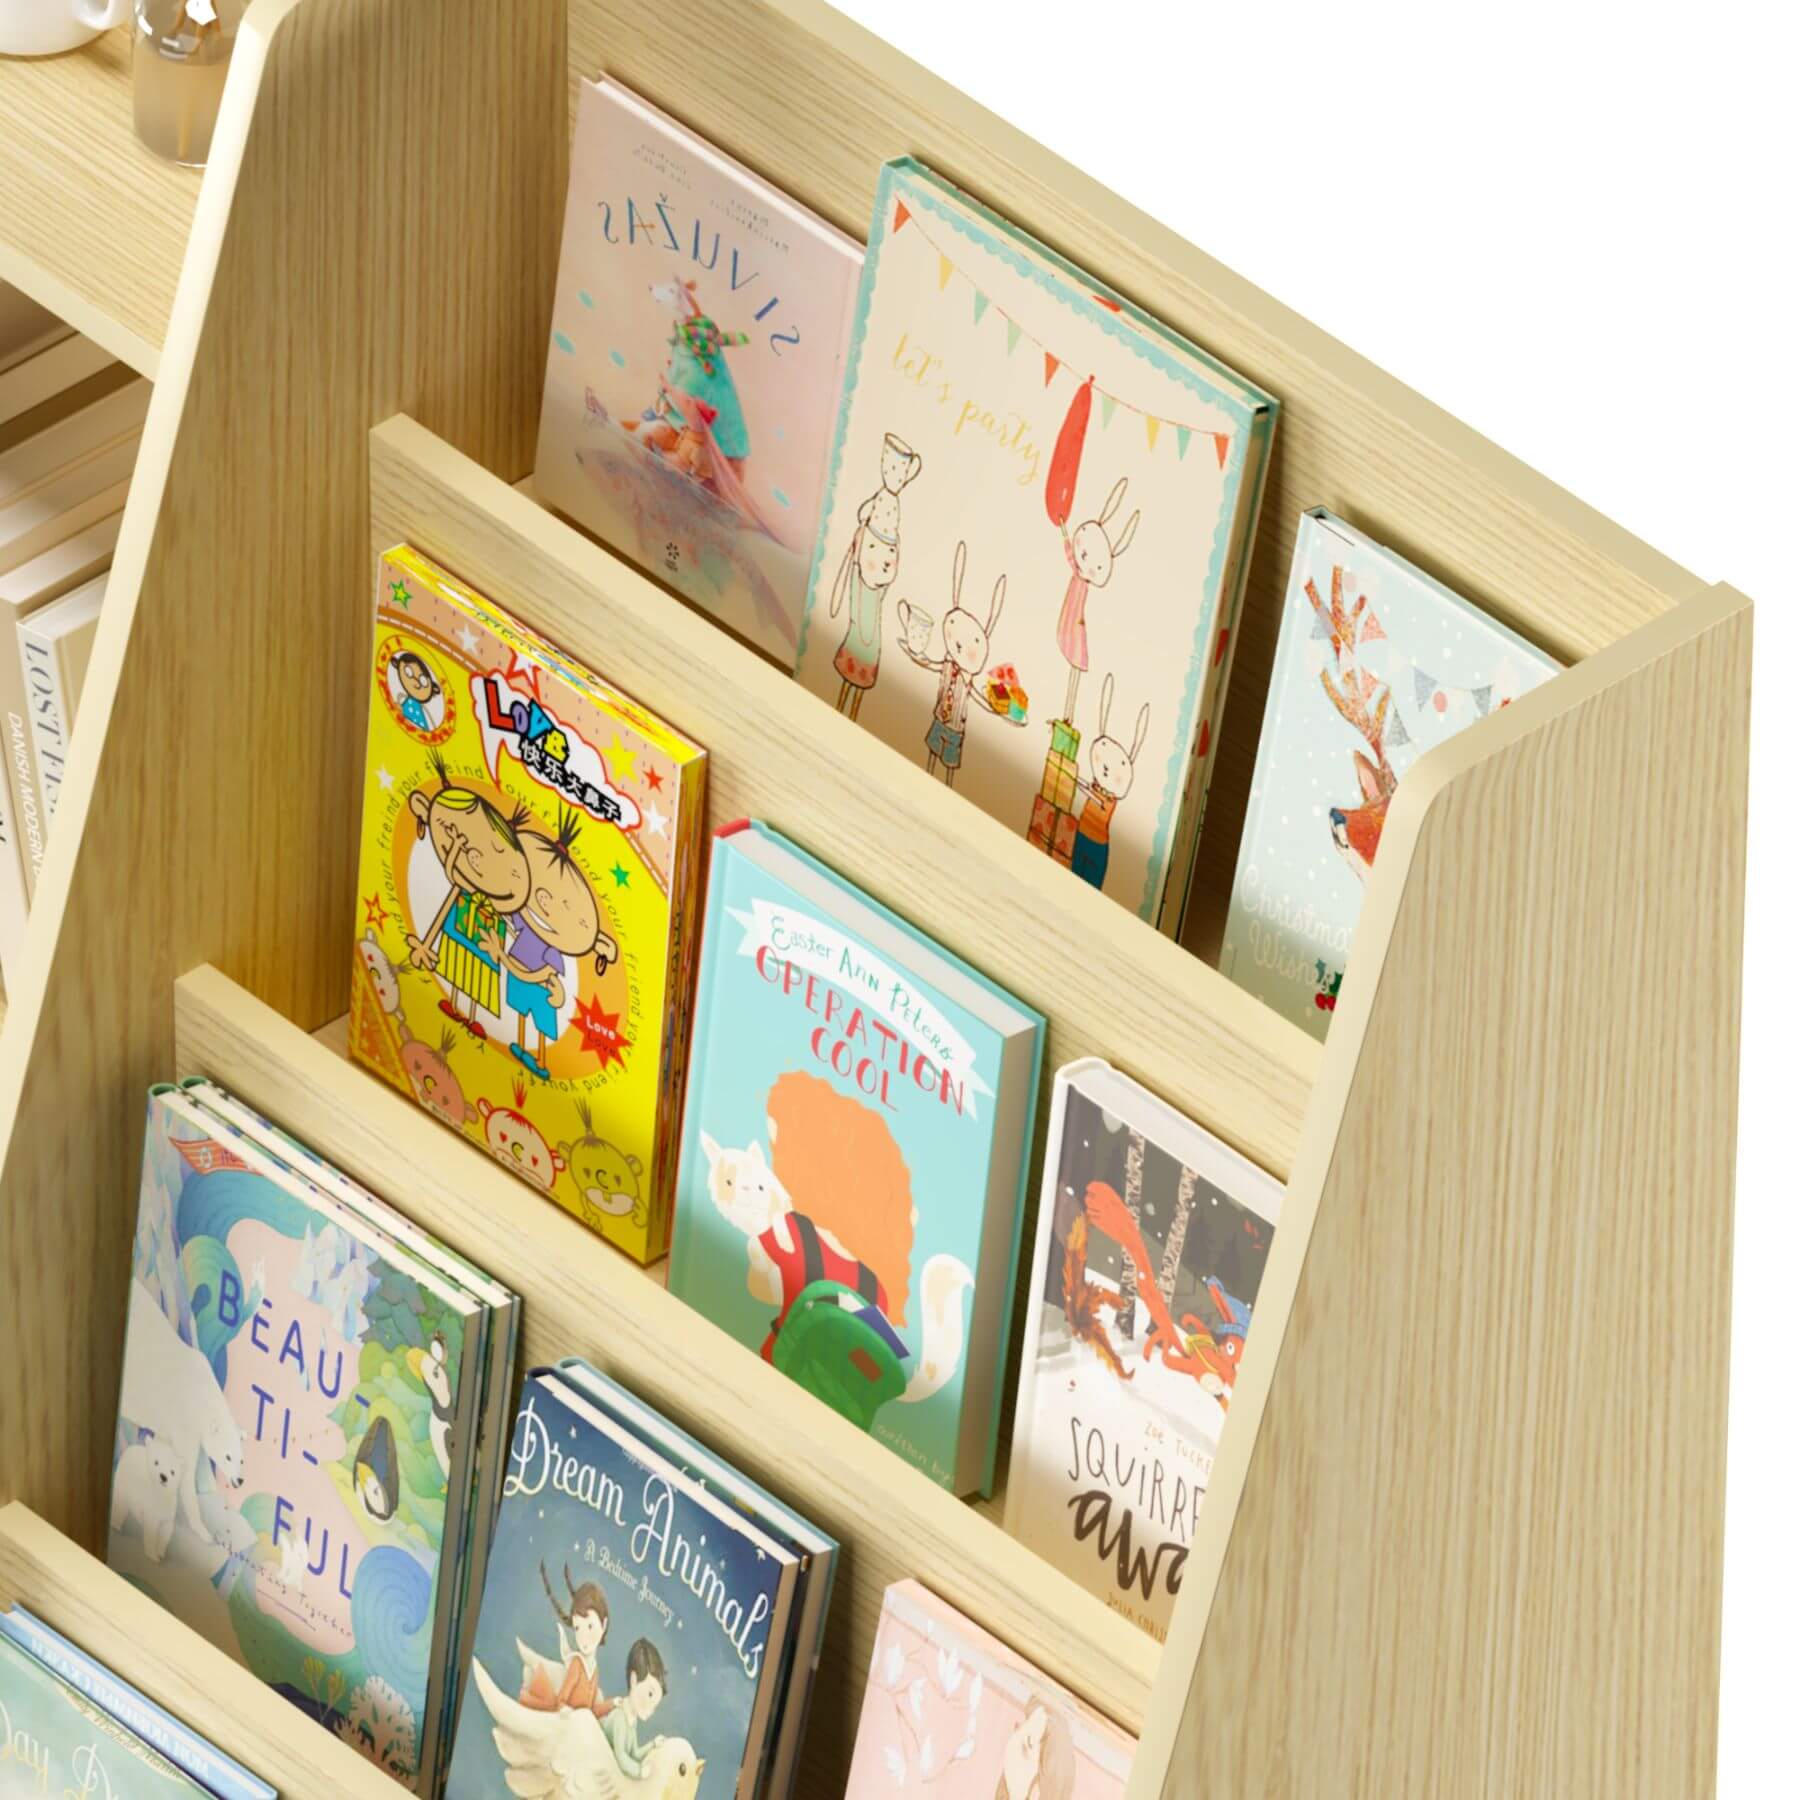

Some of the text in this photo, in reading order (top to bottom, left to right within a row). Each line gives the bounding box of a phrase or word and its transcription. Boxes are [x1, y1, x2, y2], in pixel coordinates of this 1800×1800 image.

[954, 399, 1041, 487] party
[25, 641, 62, 745] LOST
[8, 711, 43, 867] DANISH MODERN
[770, 915, 833, 959] Easter
[838, 946, 879, 992] Ann
[586, 1014, 616, 1040] Love
[756, 944, 964, 1117] OPERATION
[810, 1026, 898, 1112] COOL
[272, 1495, 352, 1600] FUL
[503, 1396, 769, 1679] Dream Animals
[598, 1546, 638, 1590] Bedtime
[638, 1575, 674, 1627] Journey
